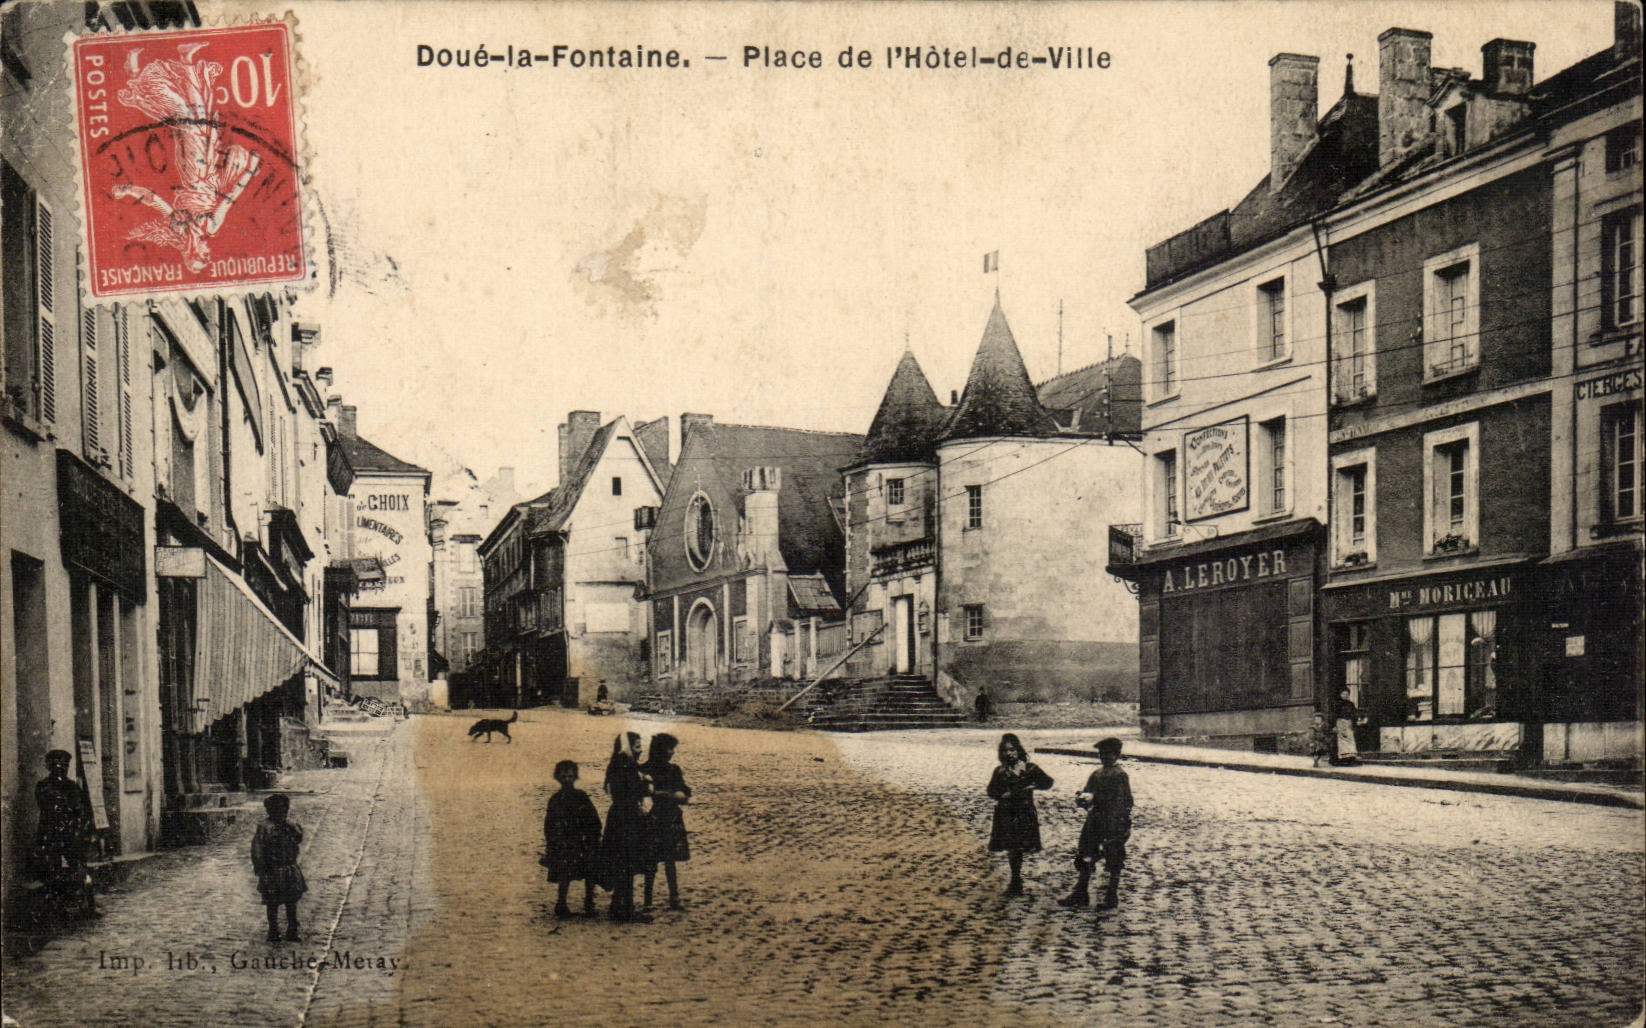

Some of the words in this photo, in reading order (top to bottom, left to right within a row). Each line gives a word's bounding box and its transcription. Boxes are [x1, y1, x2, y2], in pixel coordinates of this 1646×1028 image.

[85, 54, 110, 139] POSTES
[101, 262, 182, 288] FRANÇAISE
[368, 494, 410, 511] CHOIX
[1184, 550, 1287, 590] LEROYER
[1419, 576, 1512, 605] MORICEAU
